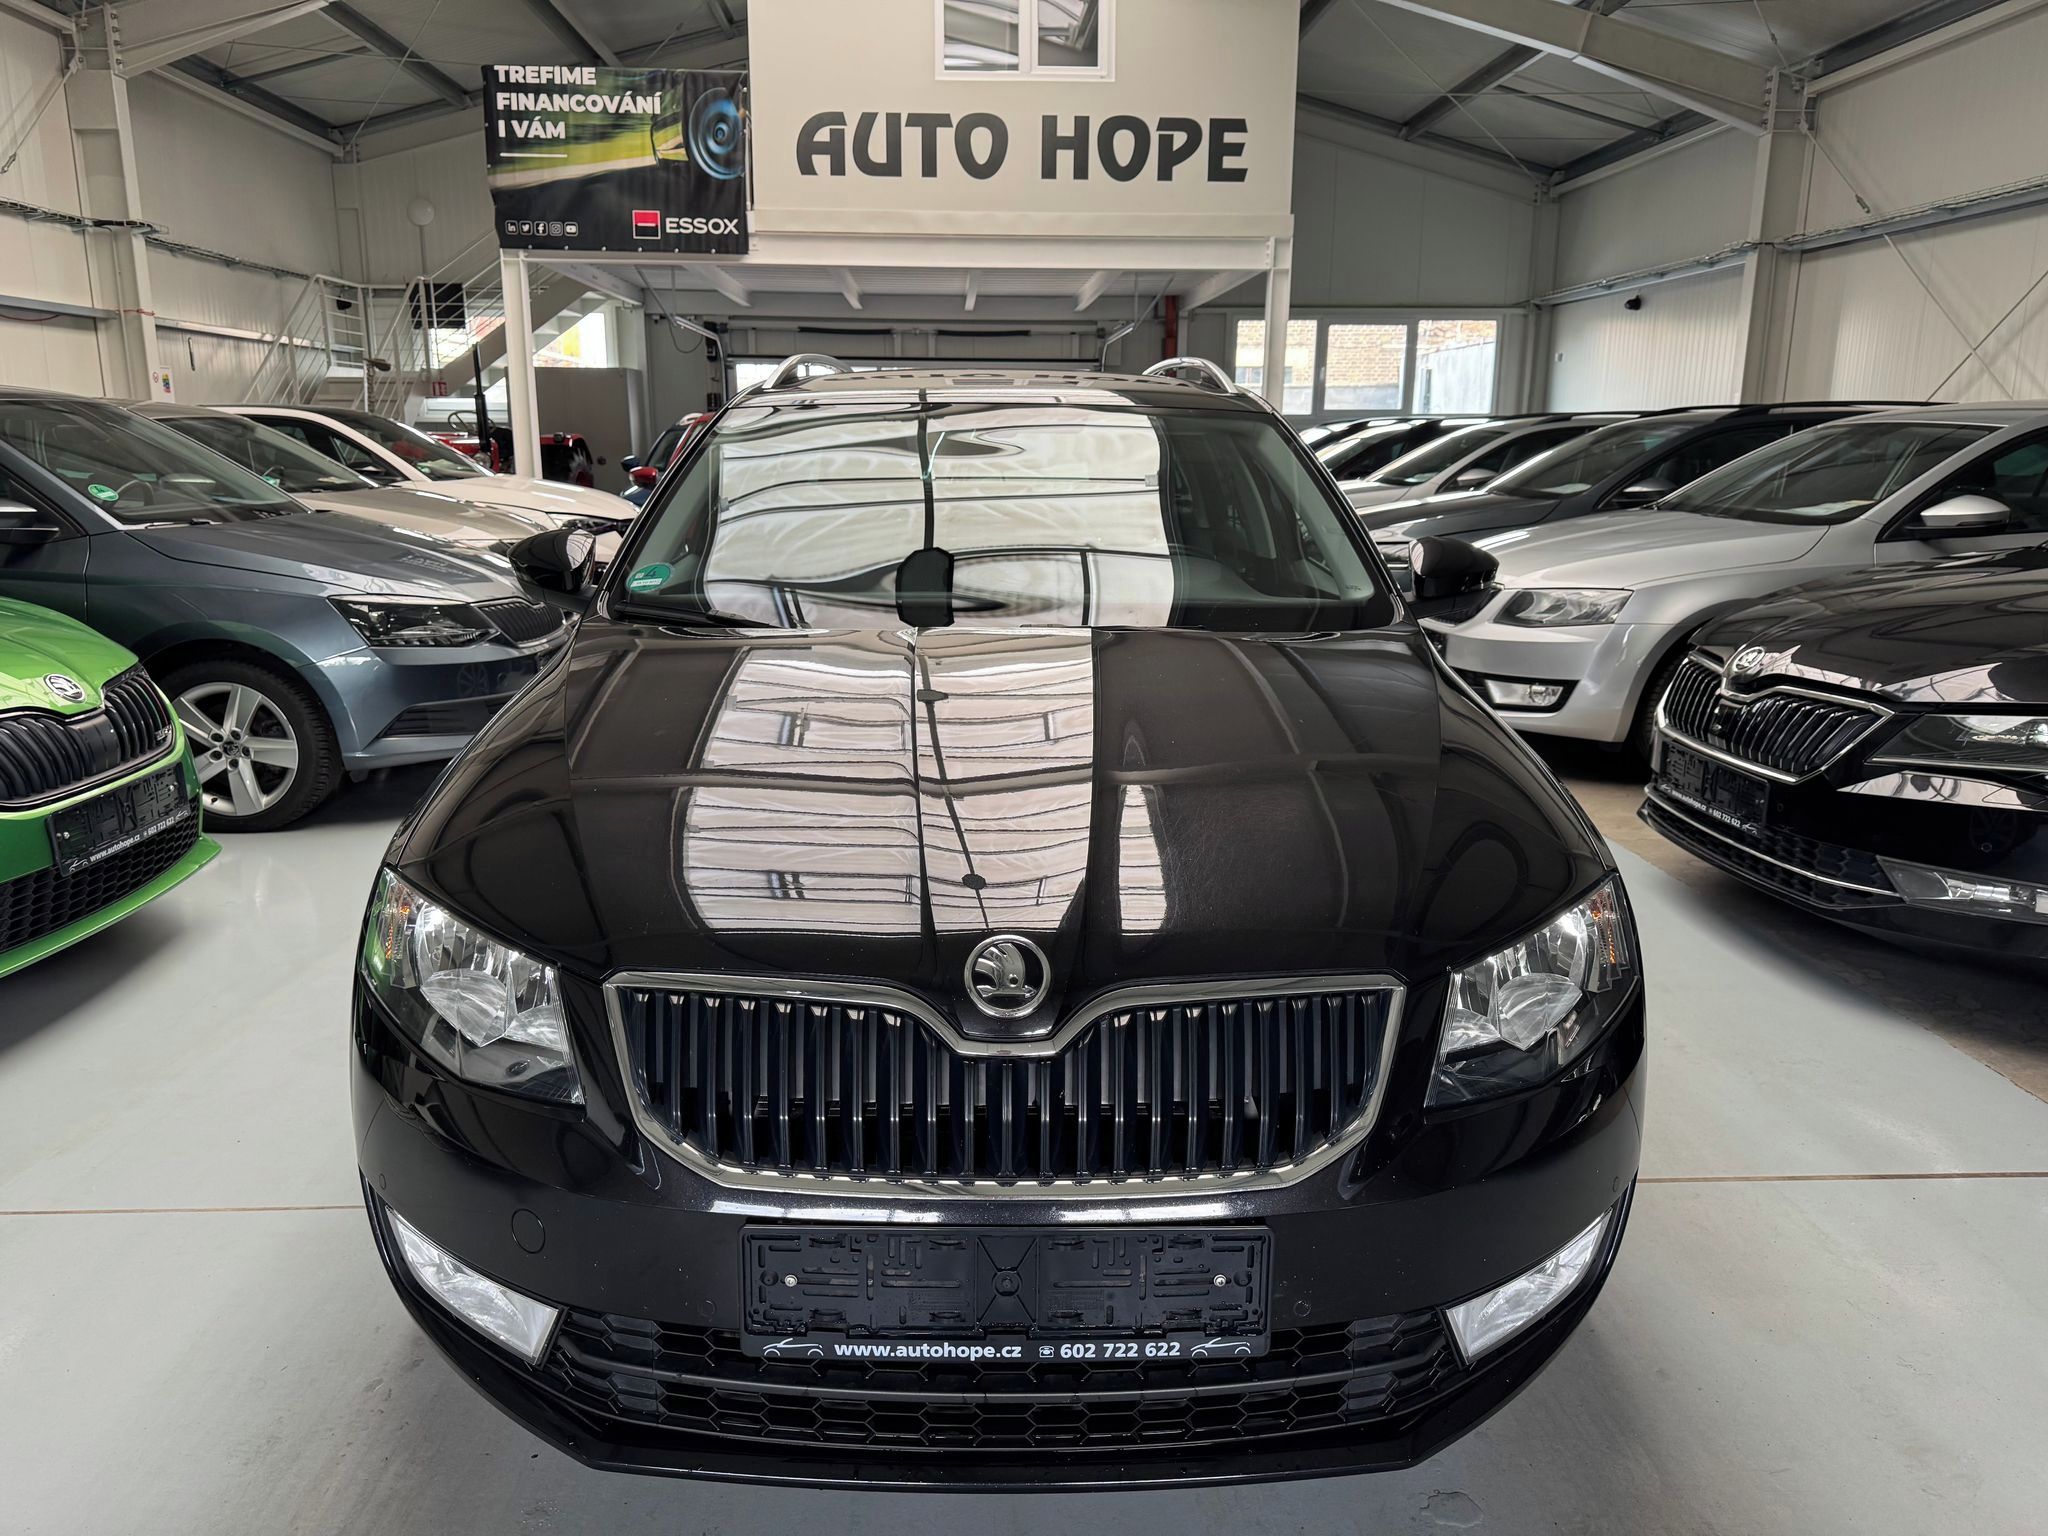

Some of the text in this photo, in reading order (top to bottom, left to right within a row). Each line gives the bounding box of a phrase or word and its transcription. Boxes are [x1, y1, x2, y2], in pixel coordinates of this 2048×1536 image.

[496, 90, 662, 115] FINANCOVÁNÍ
[498, 115, 566, 140] I VÁM
[796, 111, 1249, 183] AUTO HOPE
[665, 217, 739, 235] ESSOX
[90, 834, 140, 862] www.autohope.cz
[833, 1341, 1181, 1361] www.autohope.cz 602 722 622
